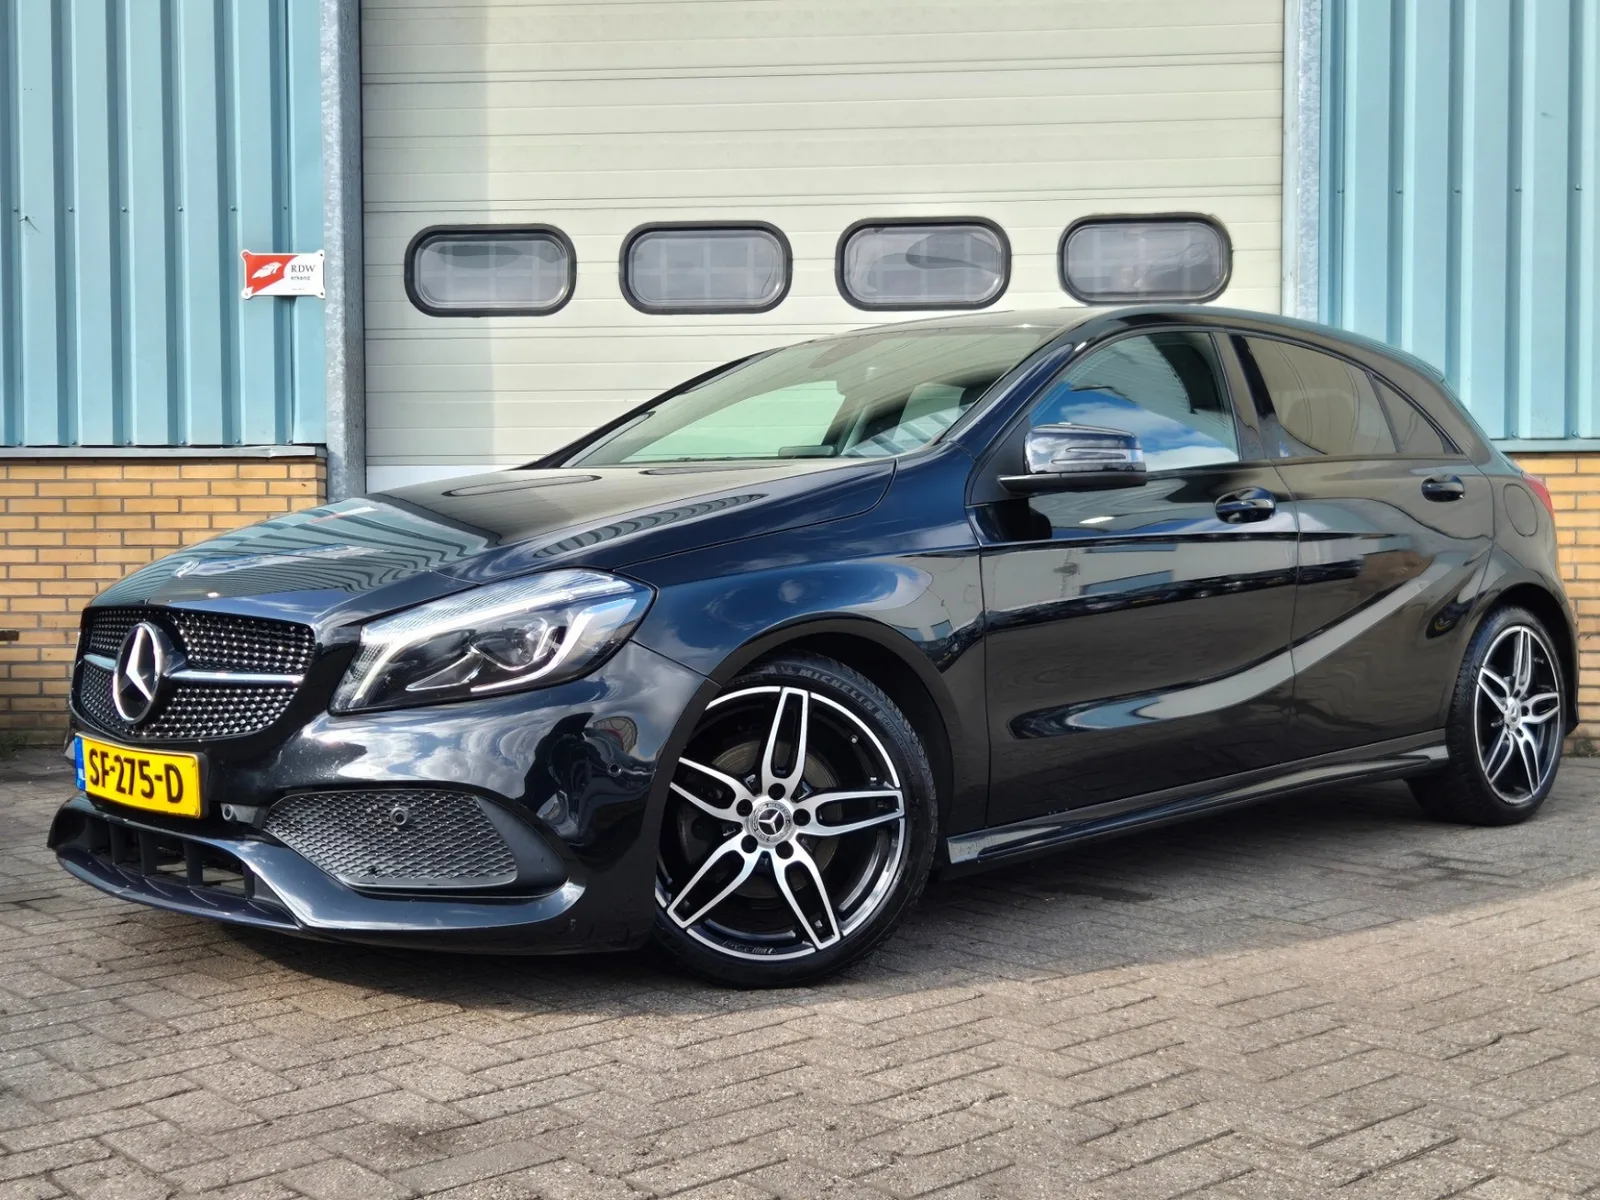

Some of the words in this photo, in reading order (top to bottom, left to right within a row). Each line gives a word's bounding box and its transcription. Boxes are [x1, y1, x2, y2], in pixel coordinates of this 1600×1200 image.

[290, 264, 316, 273] RDW
[799, 668, 875, 711] MICHELIN
[88, 748, 184, 804] SF-275-D
